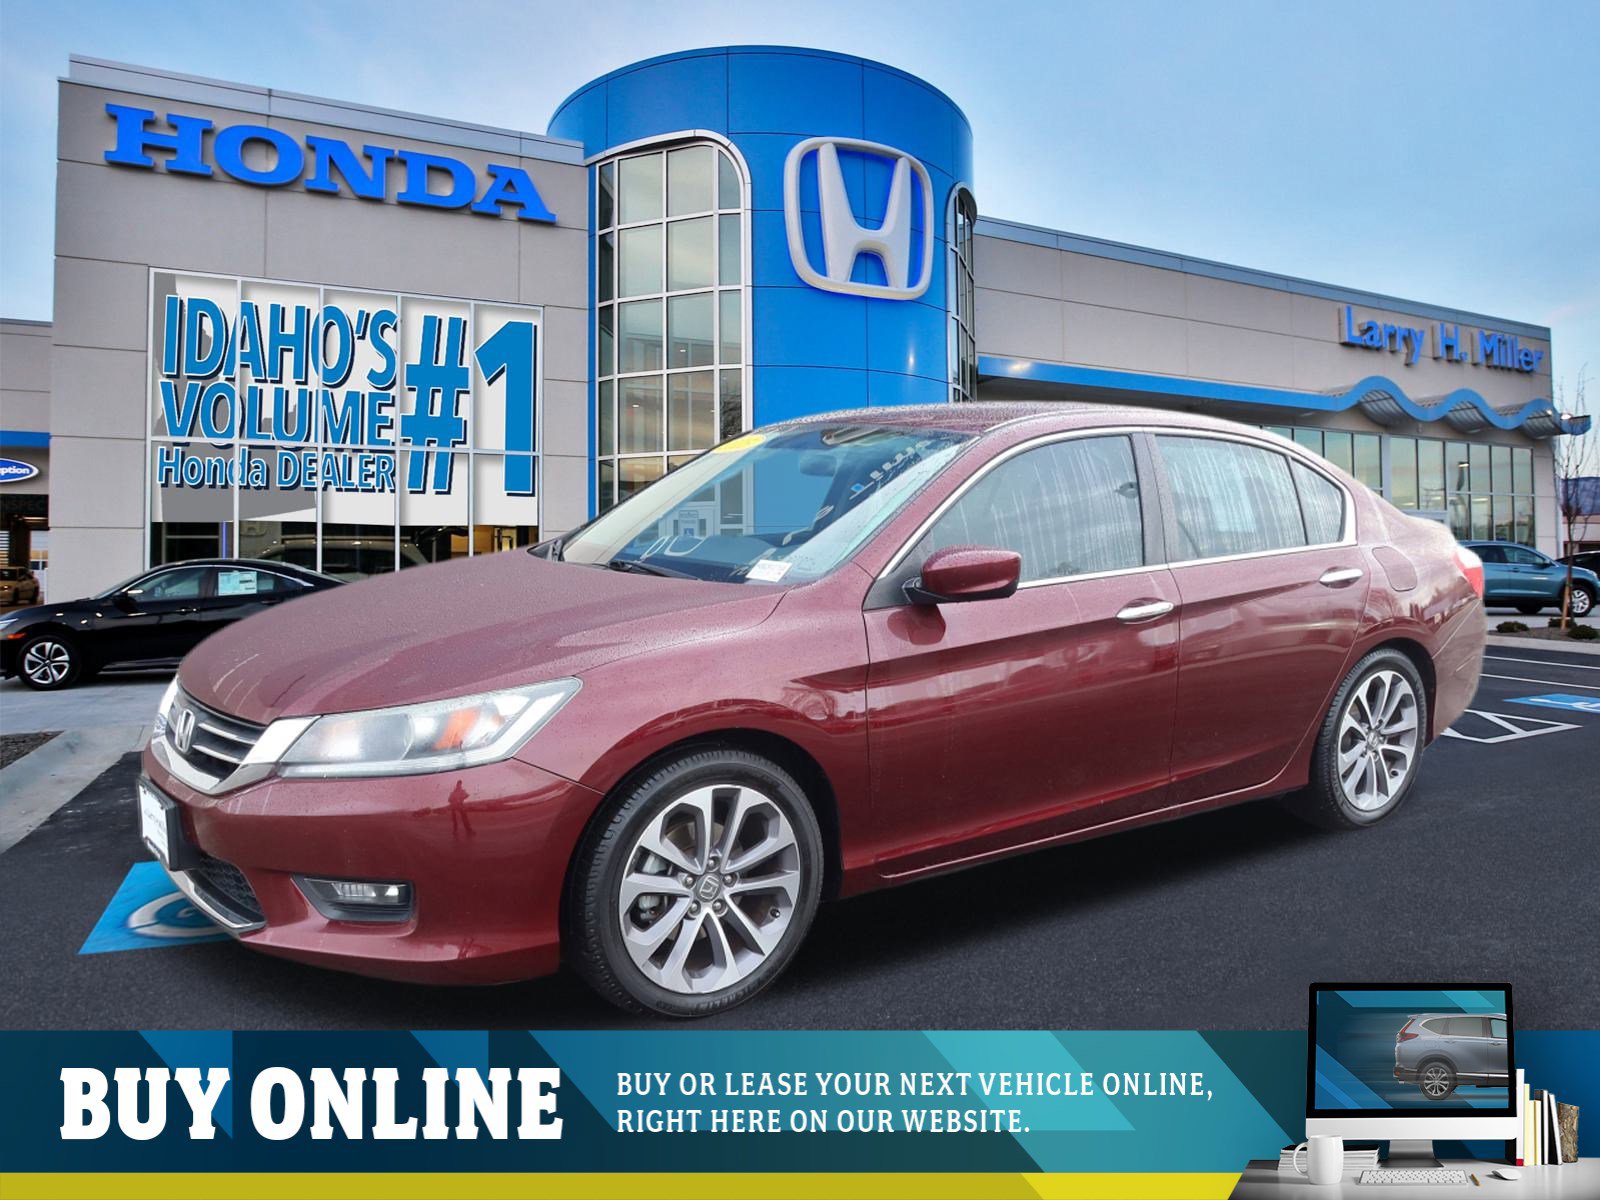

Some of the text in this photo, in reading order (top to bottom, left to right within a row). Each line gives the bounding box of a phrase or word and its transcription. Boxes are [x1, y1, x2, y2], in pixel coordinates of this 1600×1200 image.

[104, 103, 558, 224] HONDA
[162, 294, 399, 390] IDAHO'S
[1340, 305, 1545, 373] Larry H. Miller
[159, 379, 396, 451] VOLUME
[400, 314, 536, 497] #1
[0, 465, 30, 476] ption
[157, 446, 396, 493] Honda DEALER
